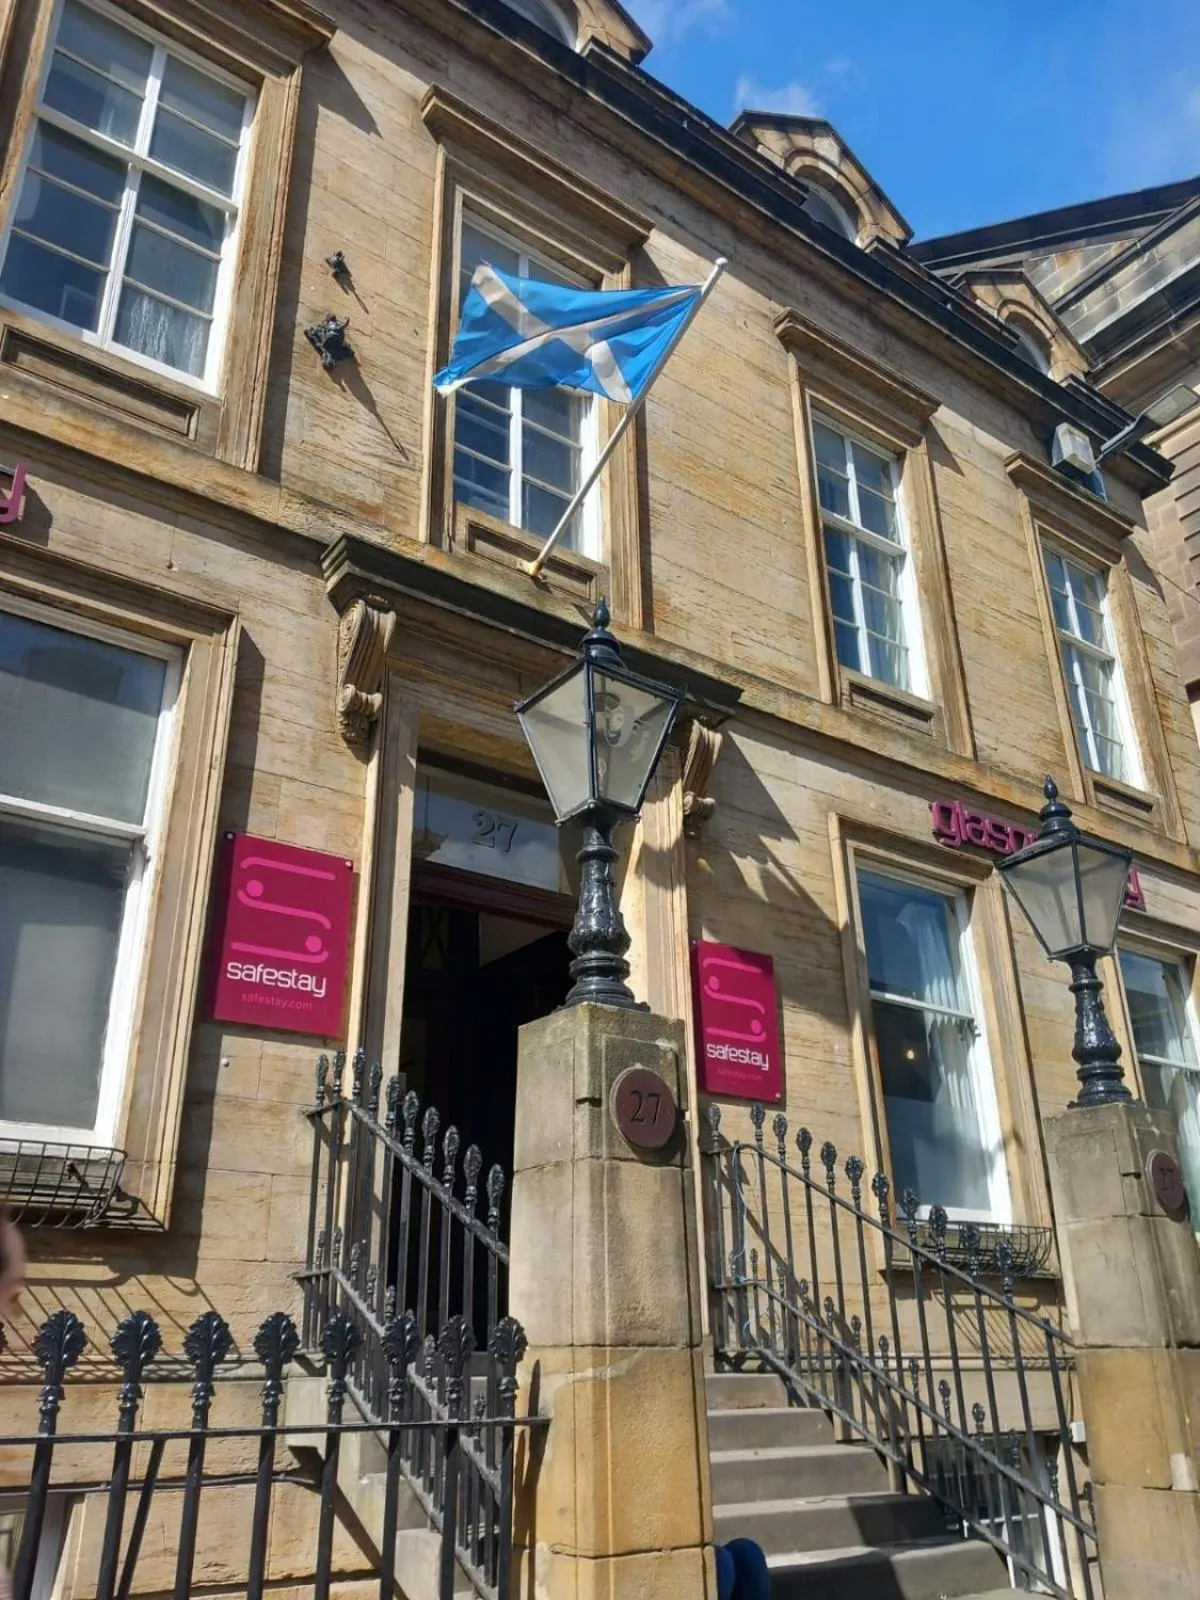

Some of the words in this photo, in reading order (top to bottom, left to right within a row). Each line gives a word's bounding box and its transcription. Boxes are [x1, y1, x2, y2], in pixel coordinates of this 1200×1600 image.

[472, 809, 519, 855] 27
[225, 960, 327, 998] safestay
[241, 992, 313, 1012] safestay.com
[706, 1042, 769, 1072] safestay
[629, 1090, 661, 1126] 27
